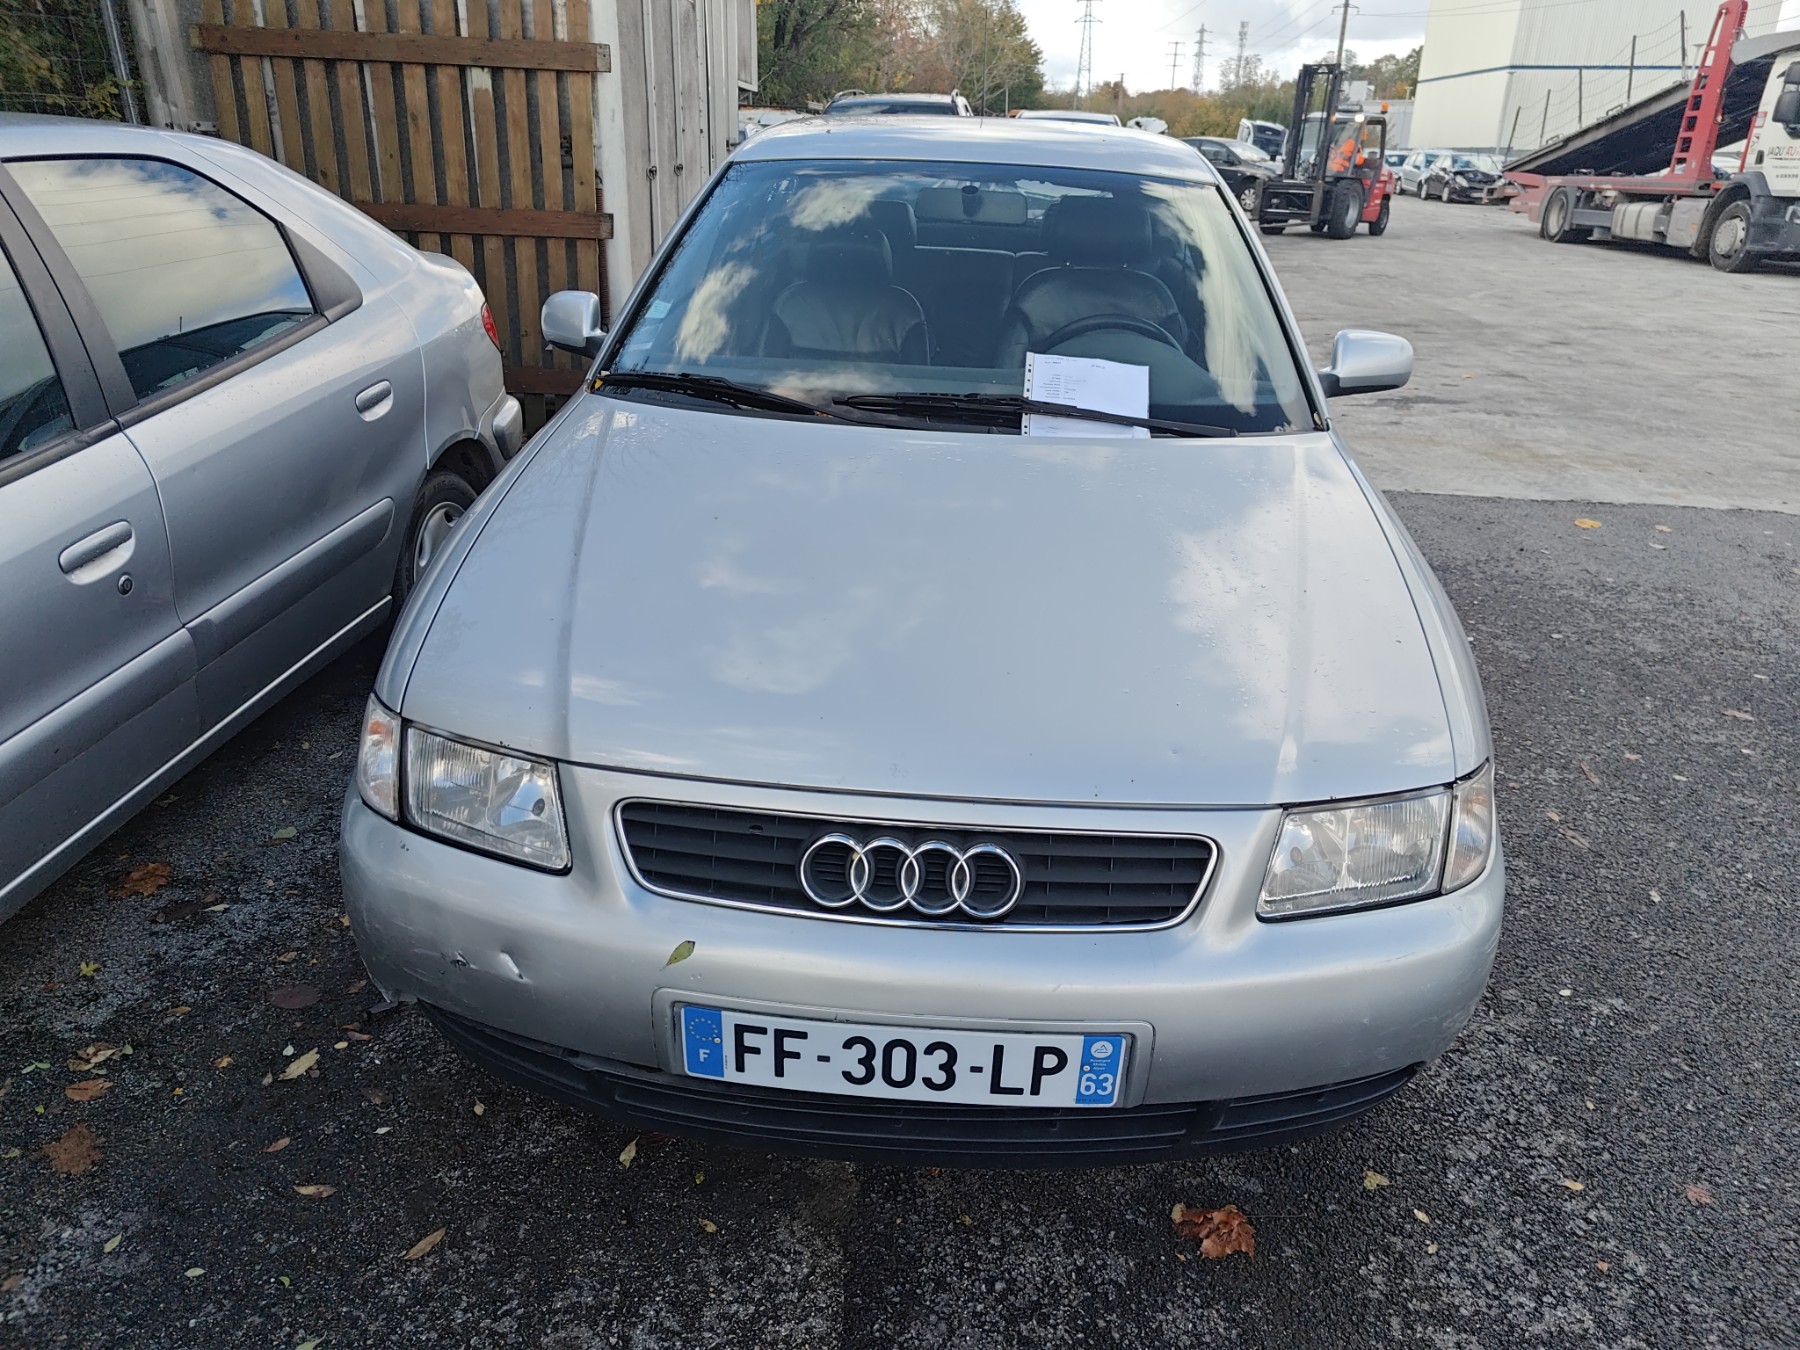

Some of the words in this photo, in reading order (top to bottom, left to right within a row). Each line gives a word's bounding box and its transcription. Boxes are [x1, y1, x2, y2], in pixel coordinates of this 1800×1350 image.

[699, 1048, 710, 1062] F
[734, 1024, 1069, 1096] FF-303-LP
[1080, 1073, 1114, 1096] 63
